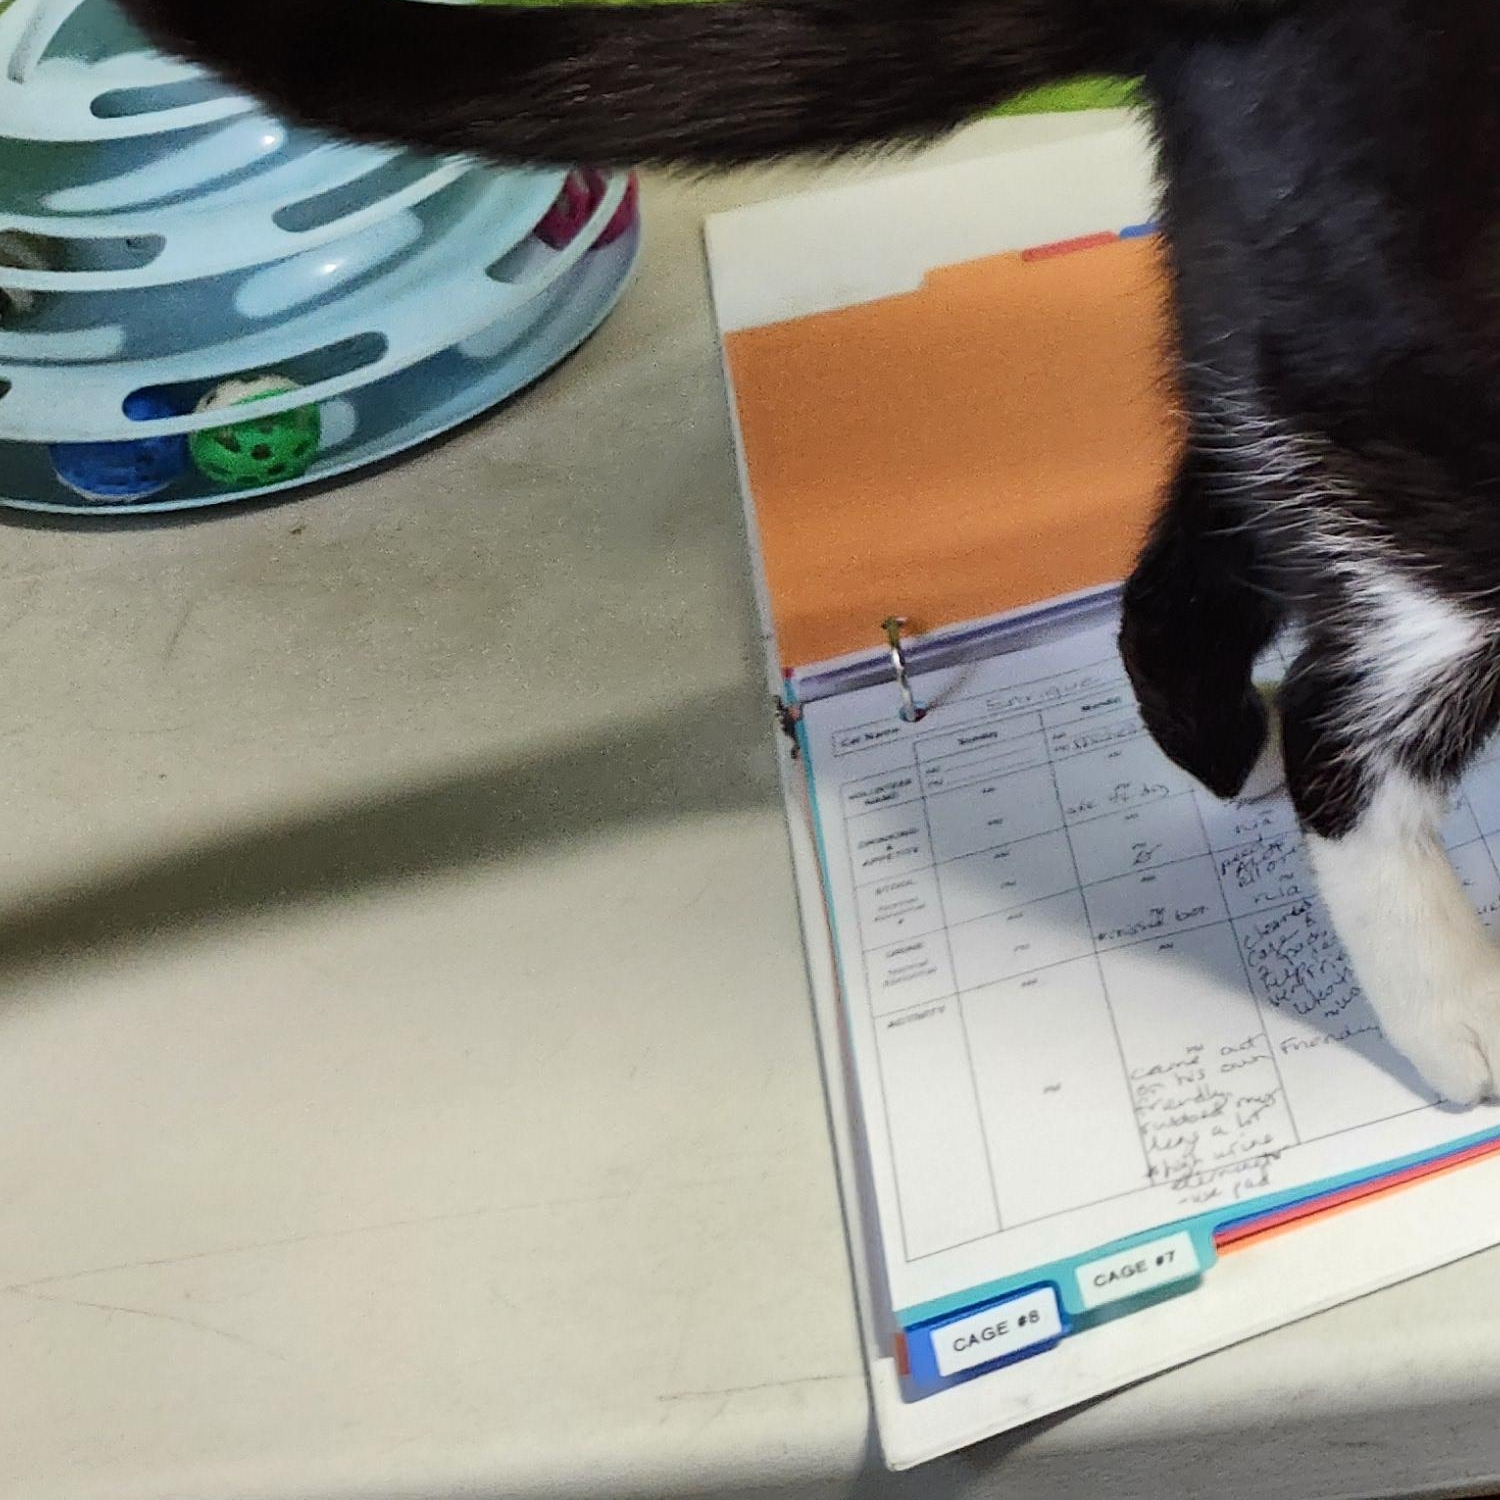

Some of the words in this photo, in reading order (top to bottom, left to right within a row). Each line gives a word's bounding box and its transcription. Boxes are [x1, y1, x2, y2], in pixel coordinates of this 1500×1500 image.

[1092, 1260, 1148, 1288] CAGE
[1154, 1250, 1177, 1268] #7
[952, 1320, 1011, 1353] CAGE
[1017, 1309, 1042, 1329] #8
